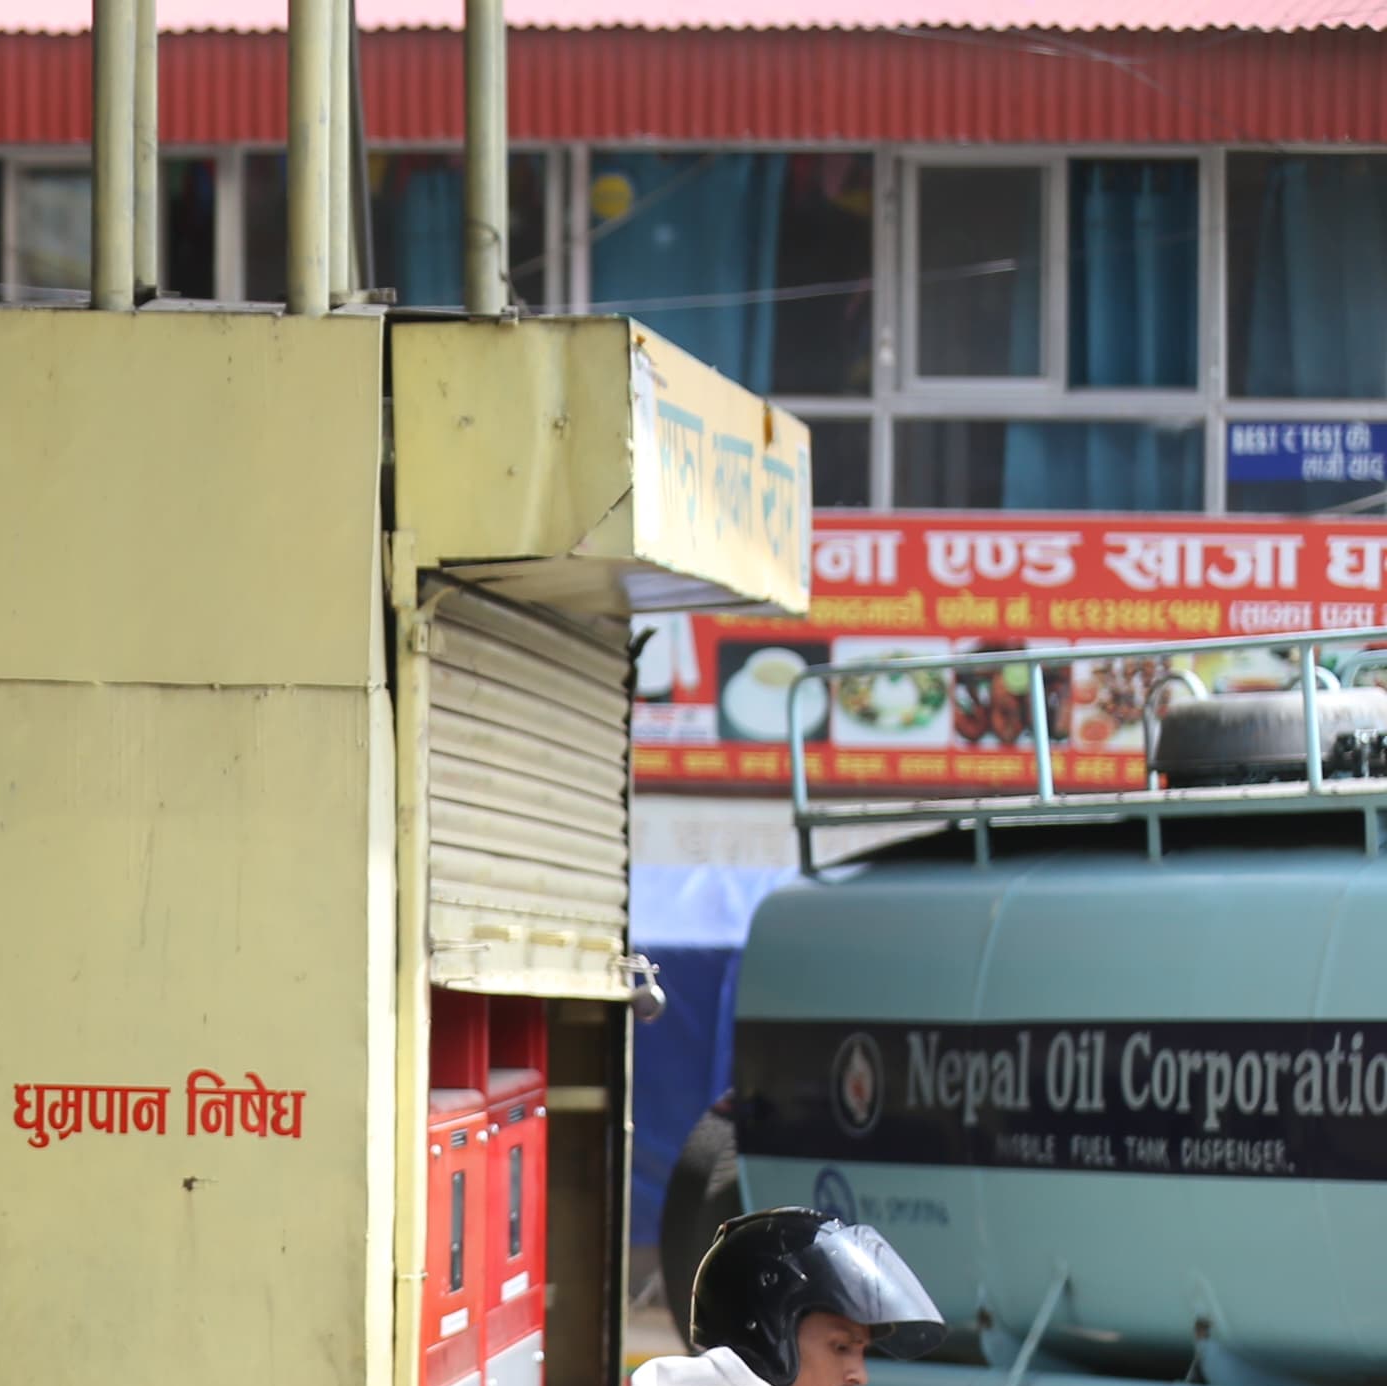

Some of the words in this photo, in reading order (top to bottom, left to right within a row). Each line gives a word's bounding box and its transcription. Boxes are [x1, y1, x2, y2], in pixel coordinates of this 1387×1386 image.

[924, 530, 1083, 587] एण्ड
[1103, 532, 1305, 591] खाजा
[1326, 535, 1387, 589] घ
[13, 1083, 171, 1149] धुम्रपान
[186, 1068, 307, 1139] निषेध
[905, 1030, 1032, 1127] Nepal
[1046, 1030, 1107, 1114] Oil
[1120, 1030, 1387, 1131] Corporatio
